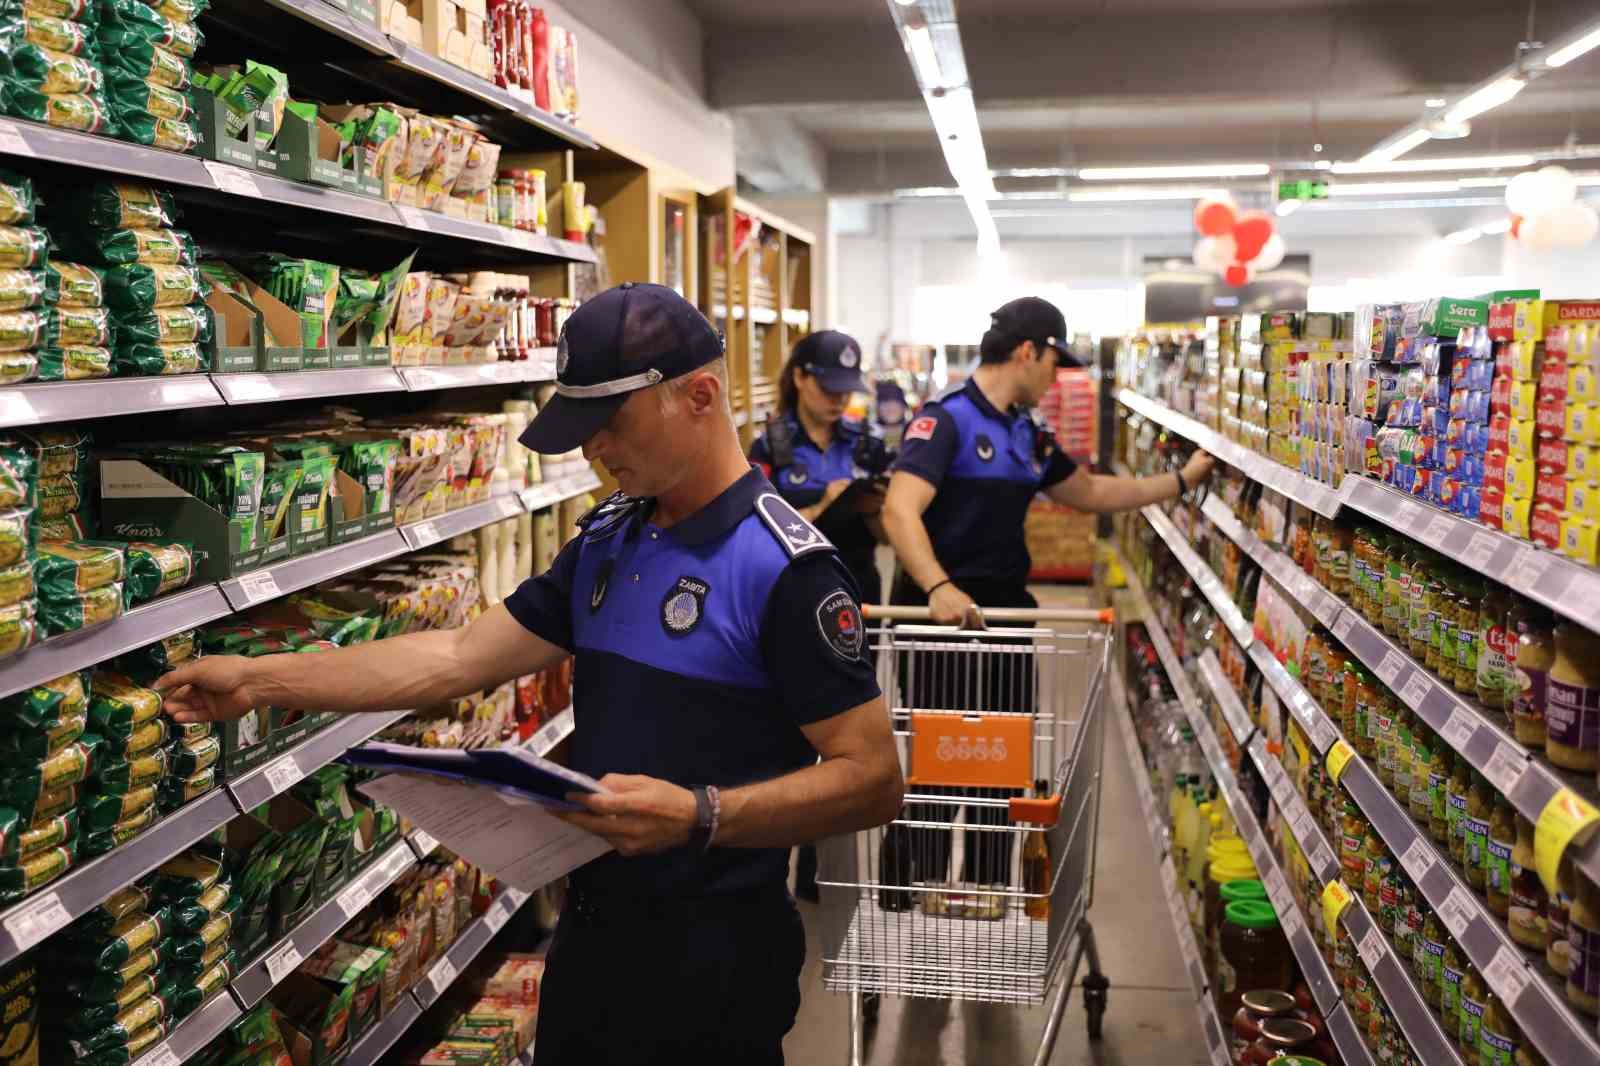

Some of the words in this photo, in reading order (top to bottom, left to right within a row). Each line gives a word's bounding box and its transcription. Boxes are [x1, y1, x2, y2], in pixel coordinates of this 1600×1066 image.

[1448, 304, 1478, 317] Sera
[113, 522, 166, 537] Knorr
[679, 578, 706, 594] ZABITA
